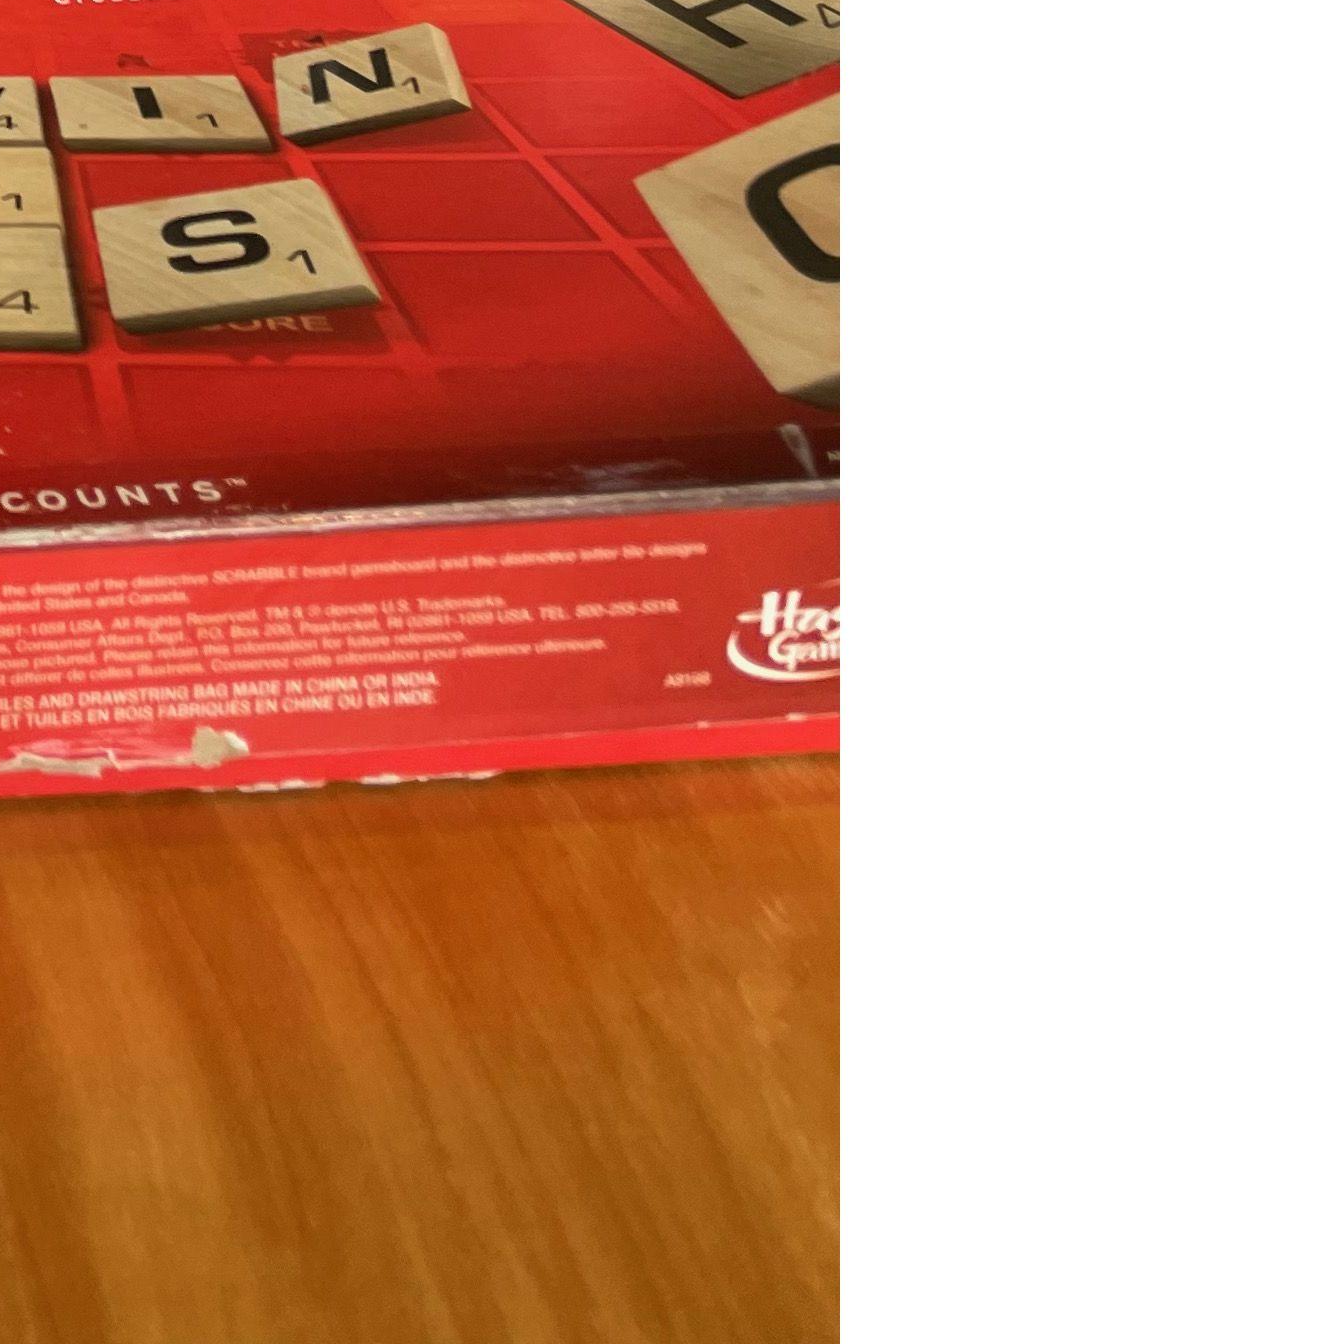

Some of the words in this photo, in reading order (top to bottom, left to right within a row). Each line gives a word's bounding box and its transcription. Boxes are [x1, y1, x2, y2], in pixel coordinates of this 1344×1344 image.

[308, 48, 395, 105] N
[402, 77, 421, 94] 1
[131, 86, 162, 120] I
[195, 112, 221, 129] 1
[2, 193, 24, 211] 1
[161, 210, 270, 274] S
[287, 249, 317, 274] 1
[39, 693, 74, 711] AND
[77, 686, 189, 708] DRAWSTRING
[193, 684, 228, 701] BAG
[232, 680, 281, 699] MADE
[285, 679, 303, 695] IN
[306, 676, 358, 694] CHINA
[362, 674, 388, 691] OR
